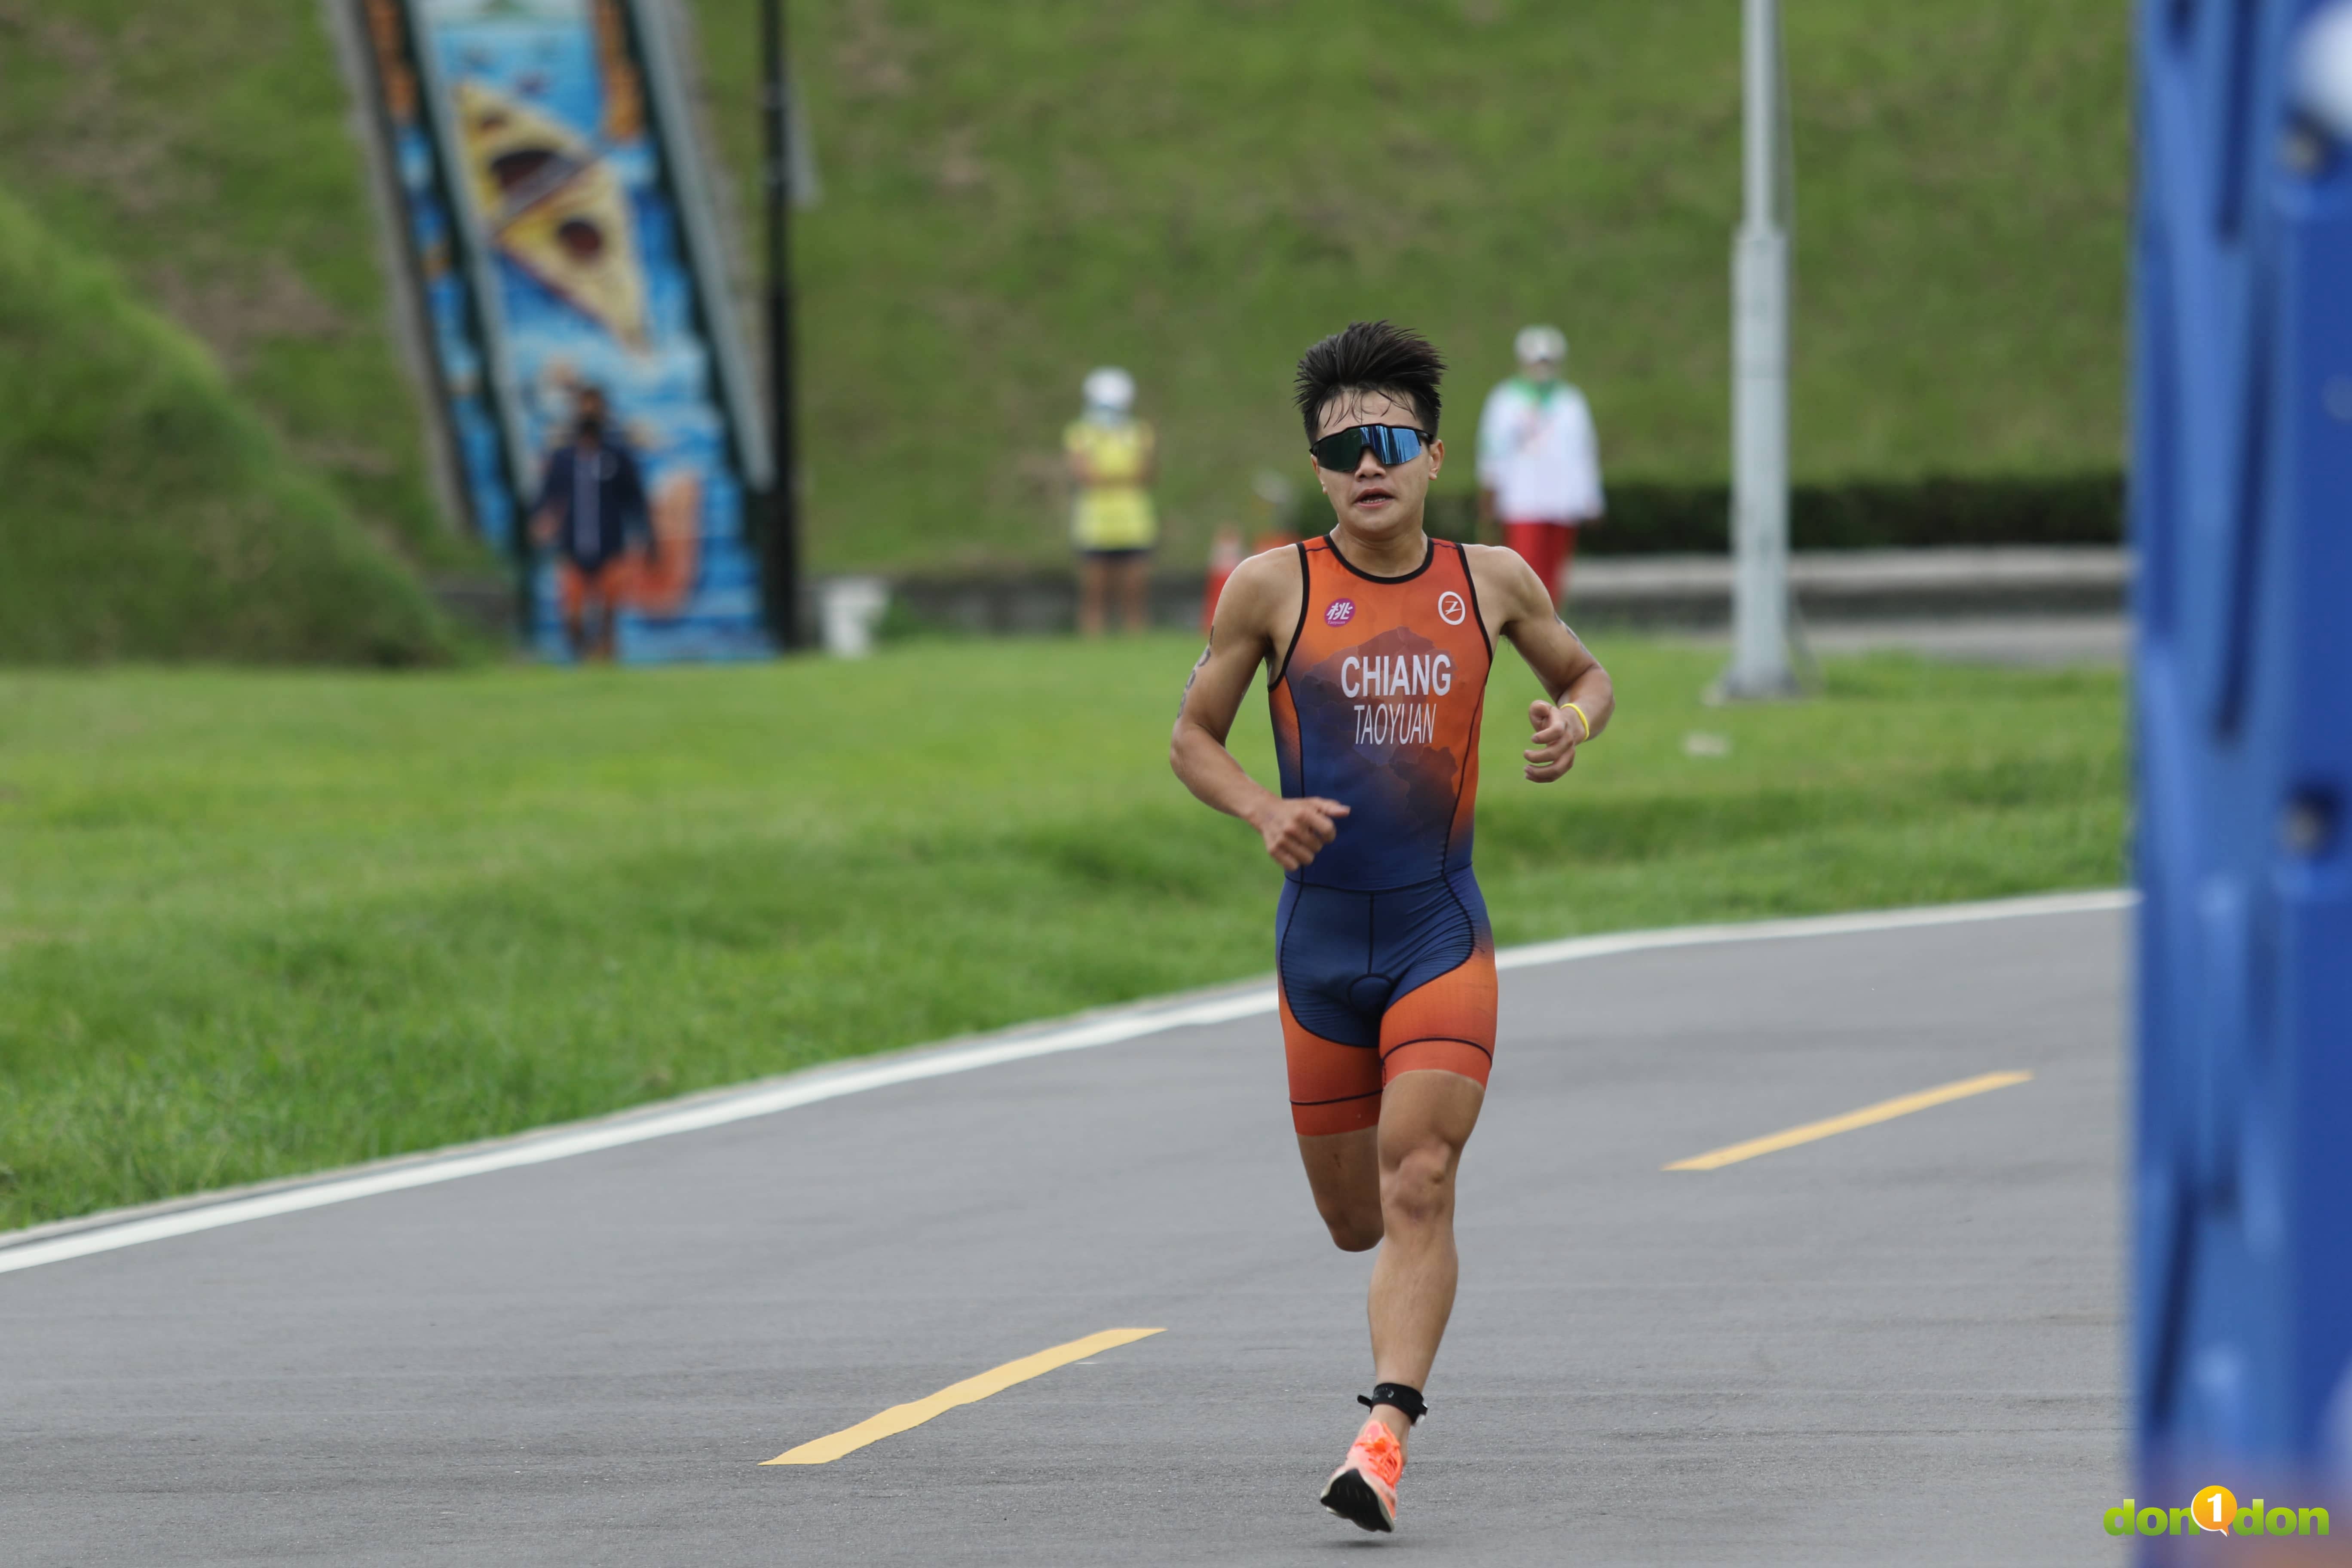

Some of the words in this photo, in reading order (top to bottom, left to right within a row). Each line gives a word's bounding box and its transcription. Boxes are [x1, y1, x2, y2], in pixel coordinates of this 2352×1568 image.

[1326, 602, 1353, 620] 桃
[1341, 654, 1451, 698] CHIANG
[1354, 703, 1436, 745] TAOYUAN
